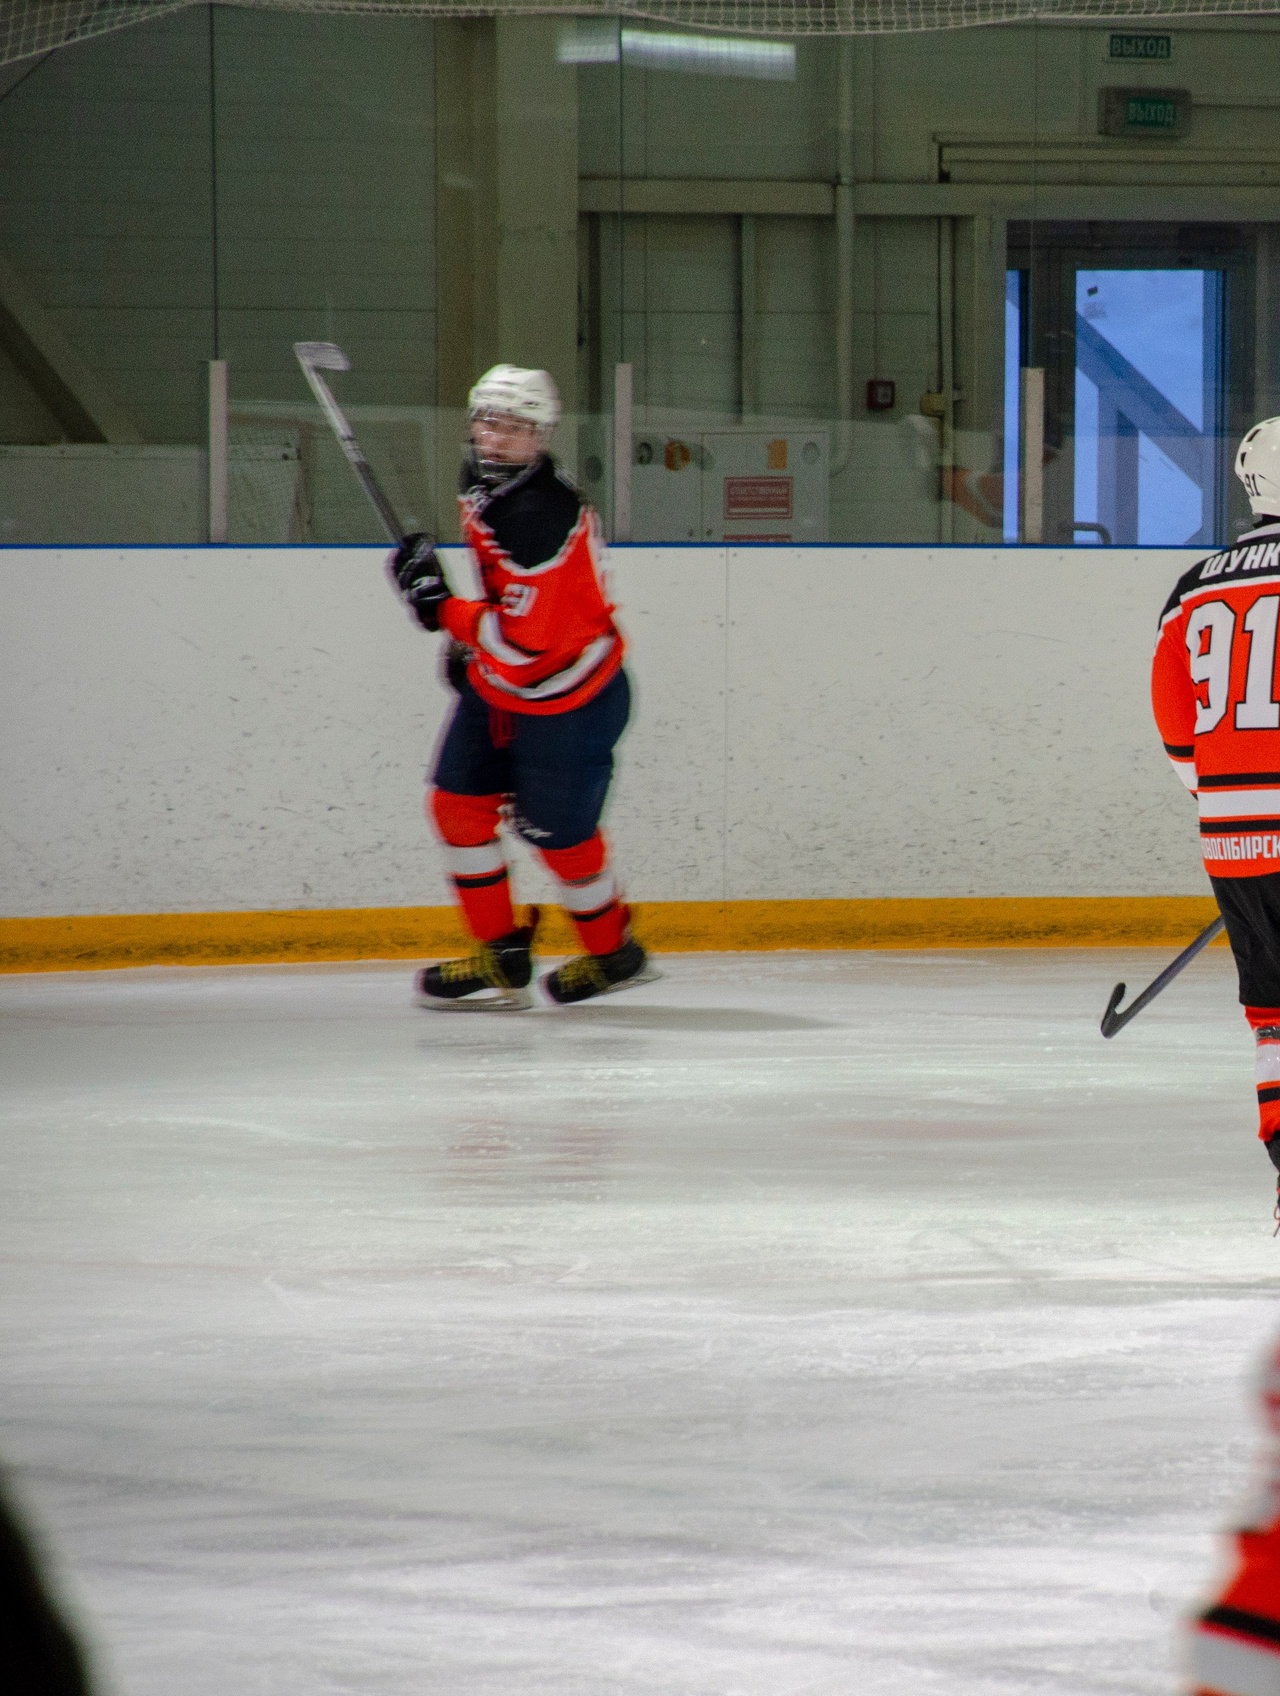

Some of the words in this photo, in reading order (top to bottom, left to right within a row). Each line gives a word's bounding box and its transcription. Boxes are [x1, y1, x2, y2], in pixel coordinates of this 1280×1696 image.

[1112, 37, 1168, 57] ВЫХОД
[1128, 102, 1174, 125] ВЫХОД
[1244, 473, 1262, 496] 91
